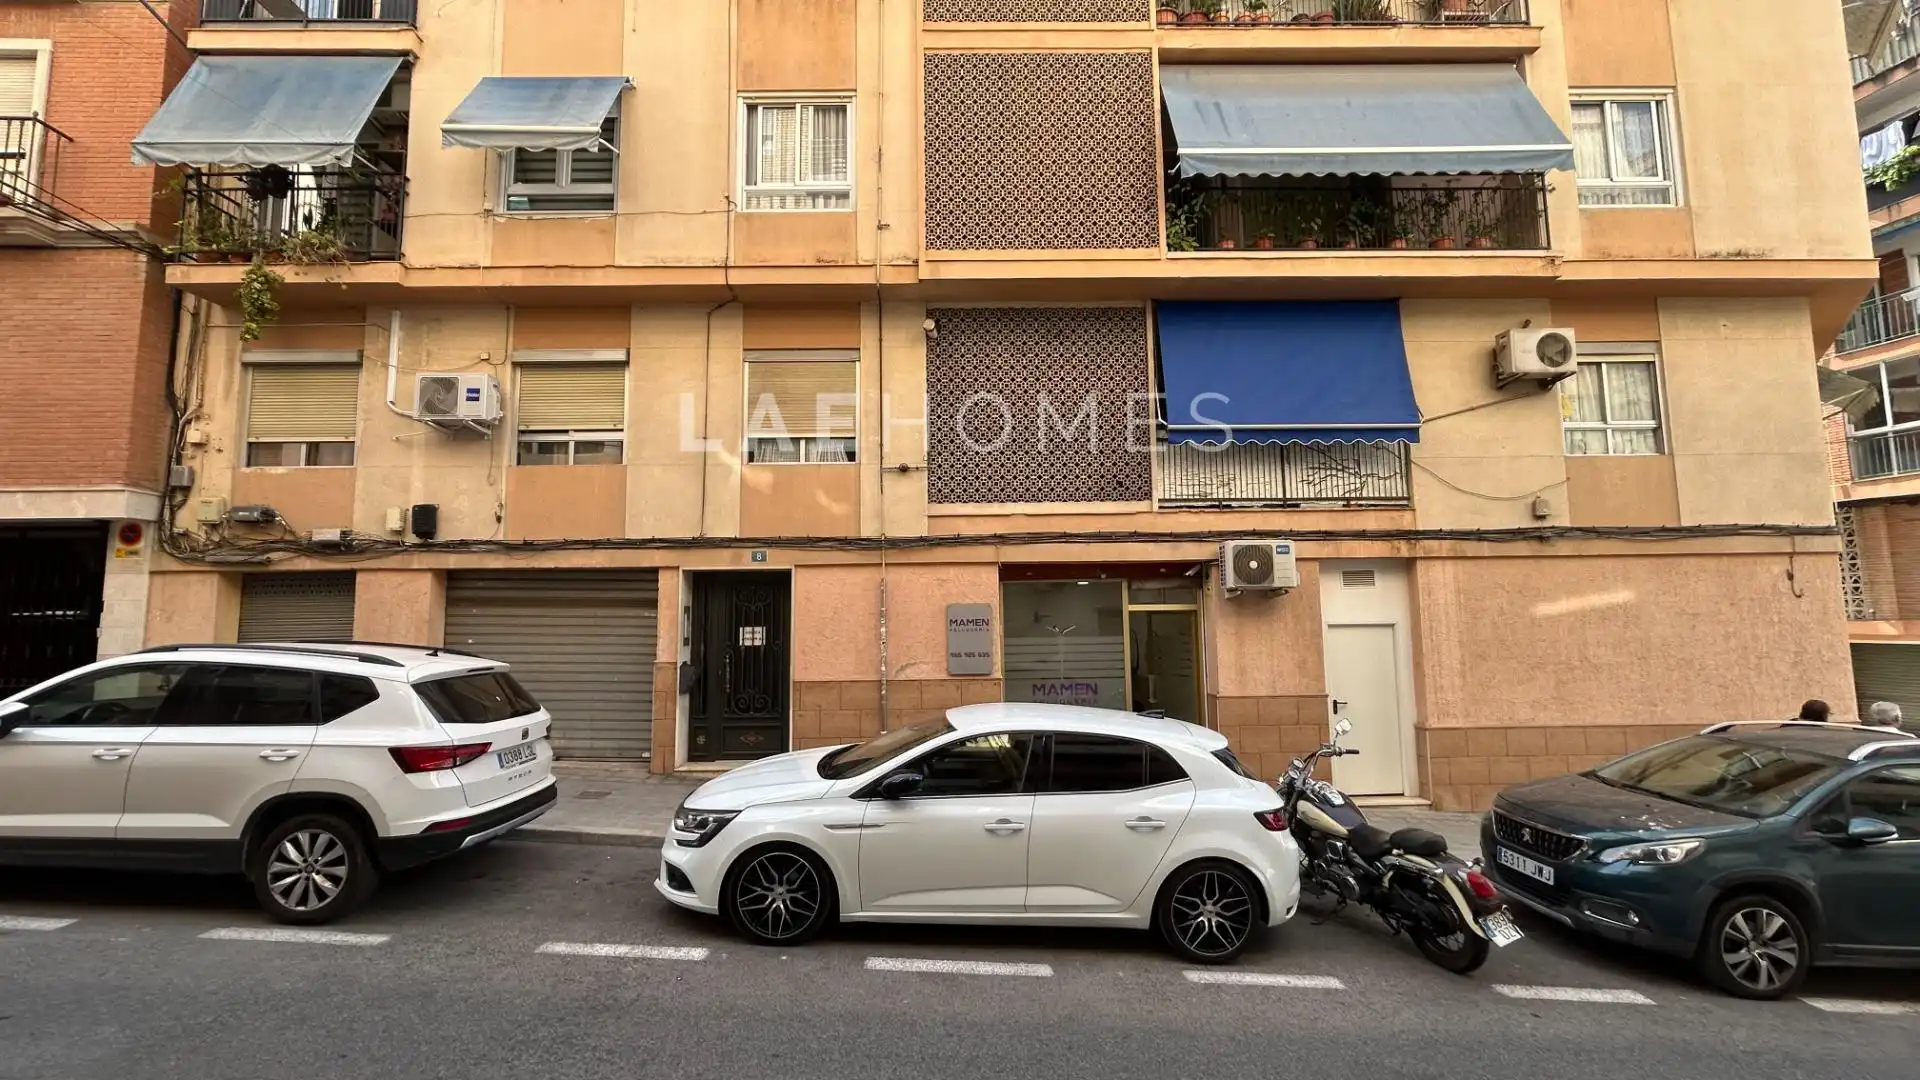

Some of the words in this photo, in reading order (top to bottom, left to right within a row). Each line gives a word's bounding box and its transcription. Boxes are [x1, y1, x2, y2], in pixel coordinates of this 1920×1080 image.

[756, 552, 762, 561] 8
[949, 618, 990, 627] MAMEN
[1032, 682, 1098, 696] MAMEN
[503, 749, 522, 764] 0388
[1503, 850, 1526, 871] 5311
[1531, 863, 1551, 882] JWJ
